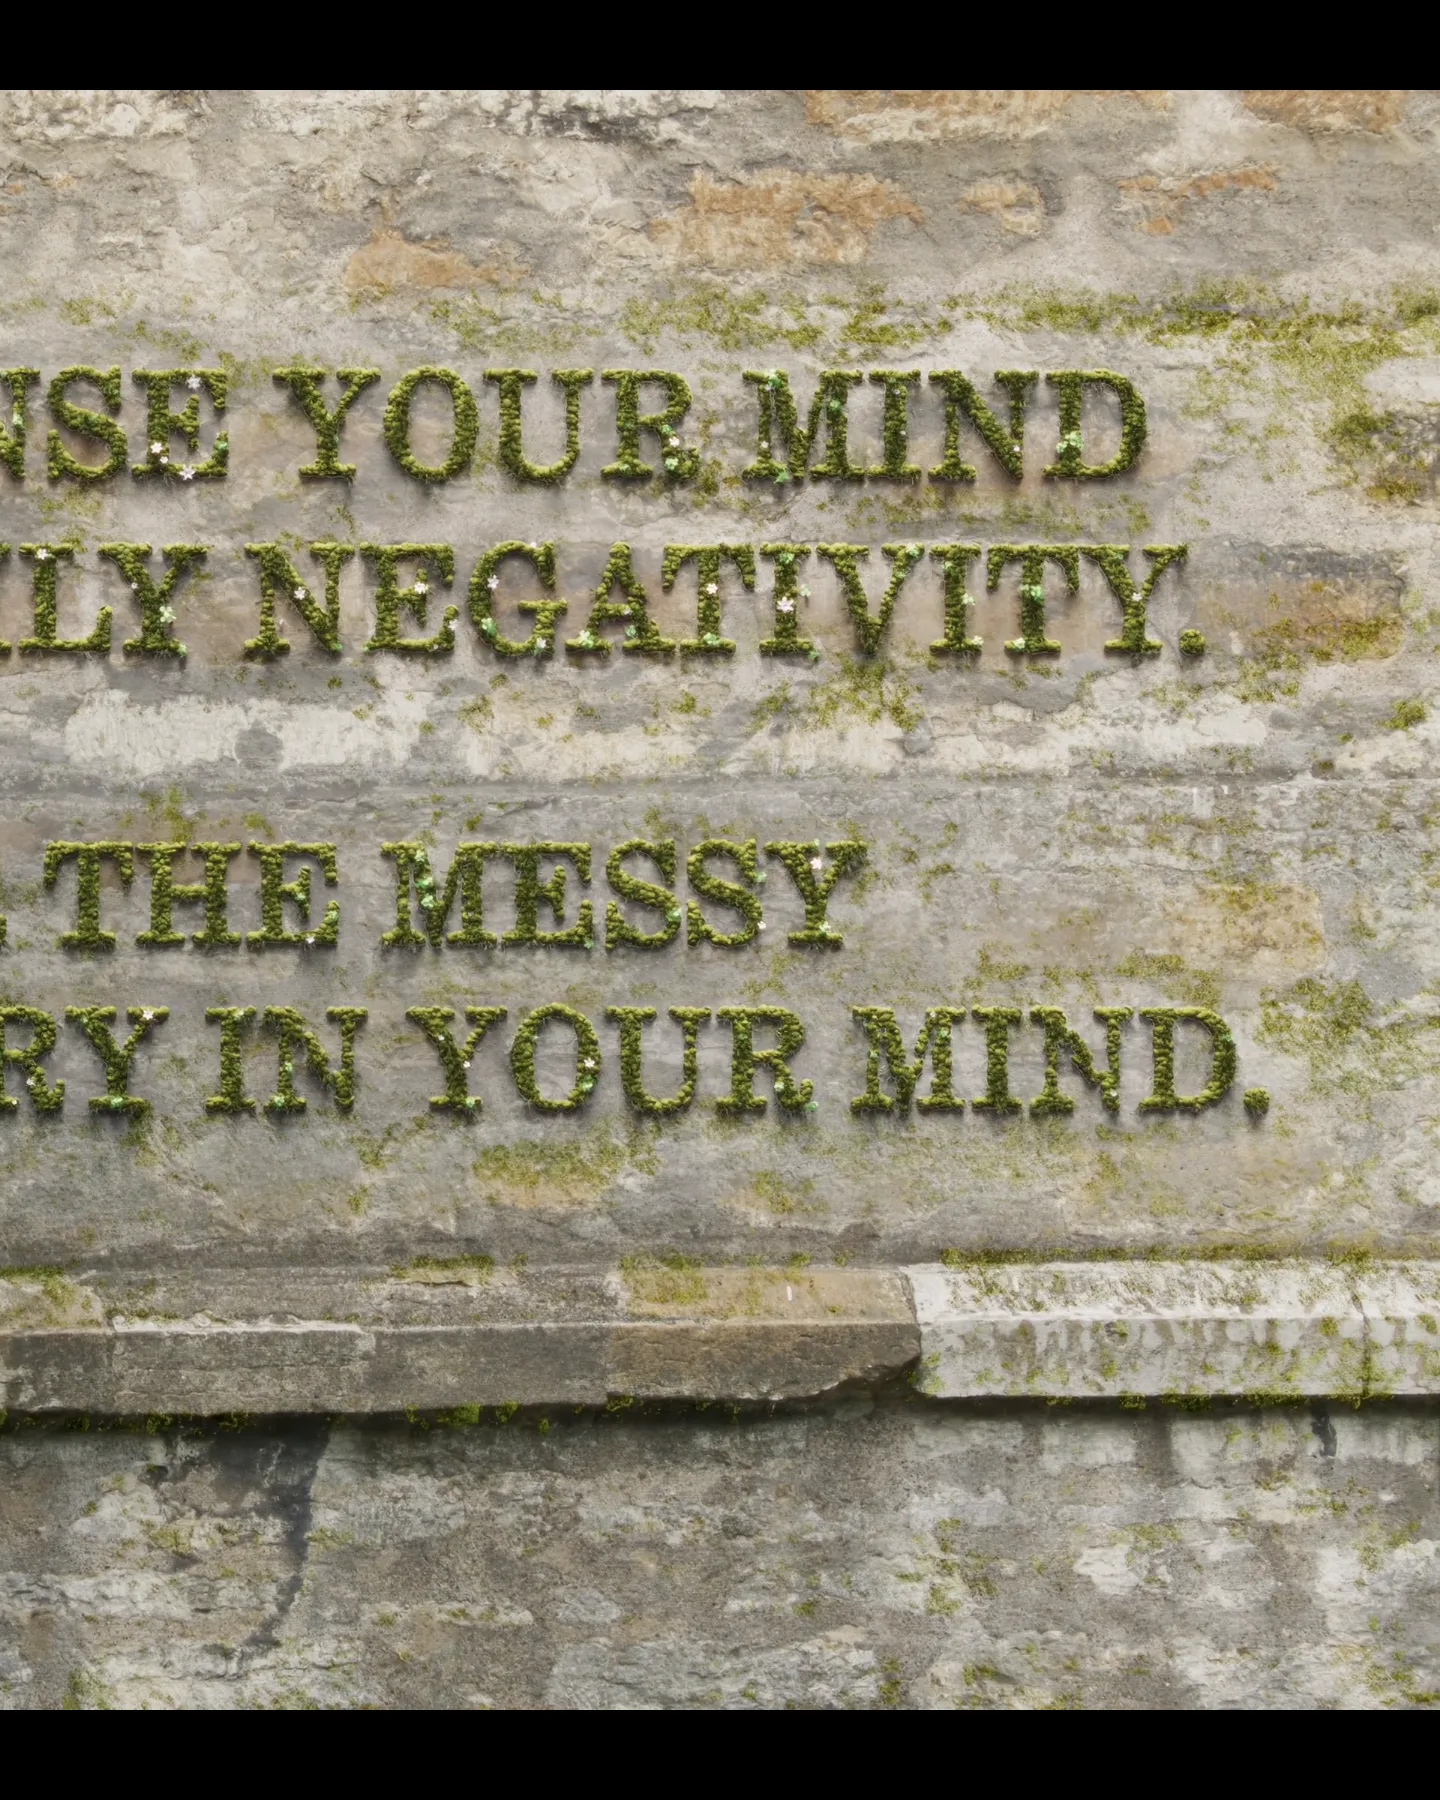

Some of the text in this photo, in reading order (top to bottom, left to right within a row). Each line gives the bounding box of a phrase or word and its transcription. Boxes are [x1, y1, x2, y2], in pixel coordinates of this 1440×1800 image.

[275, 367, 696, 480] YOUR
[745, 368, 1148, 480] MIND
[247, 539, 1206, 657] NEGATIVITY.
[46, 839, 340, 949] THE
[381, 839, 865, 949] MESSY
[207, 1005, 364, 1115] IN
[408, 1005, 813, 1115] YOUR
[850, 1005, 1269, 1114] MIND.
